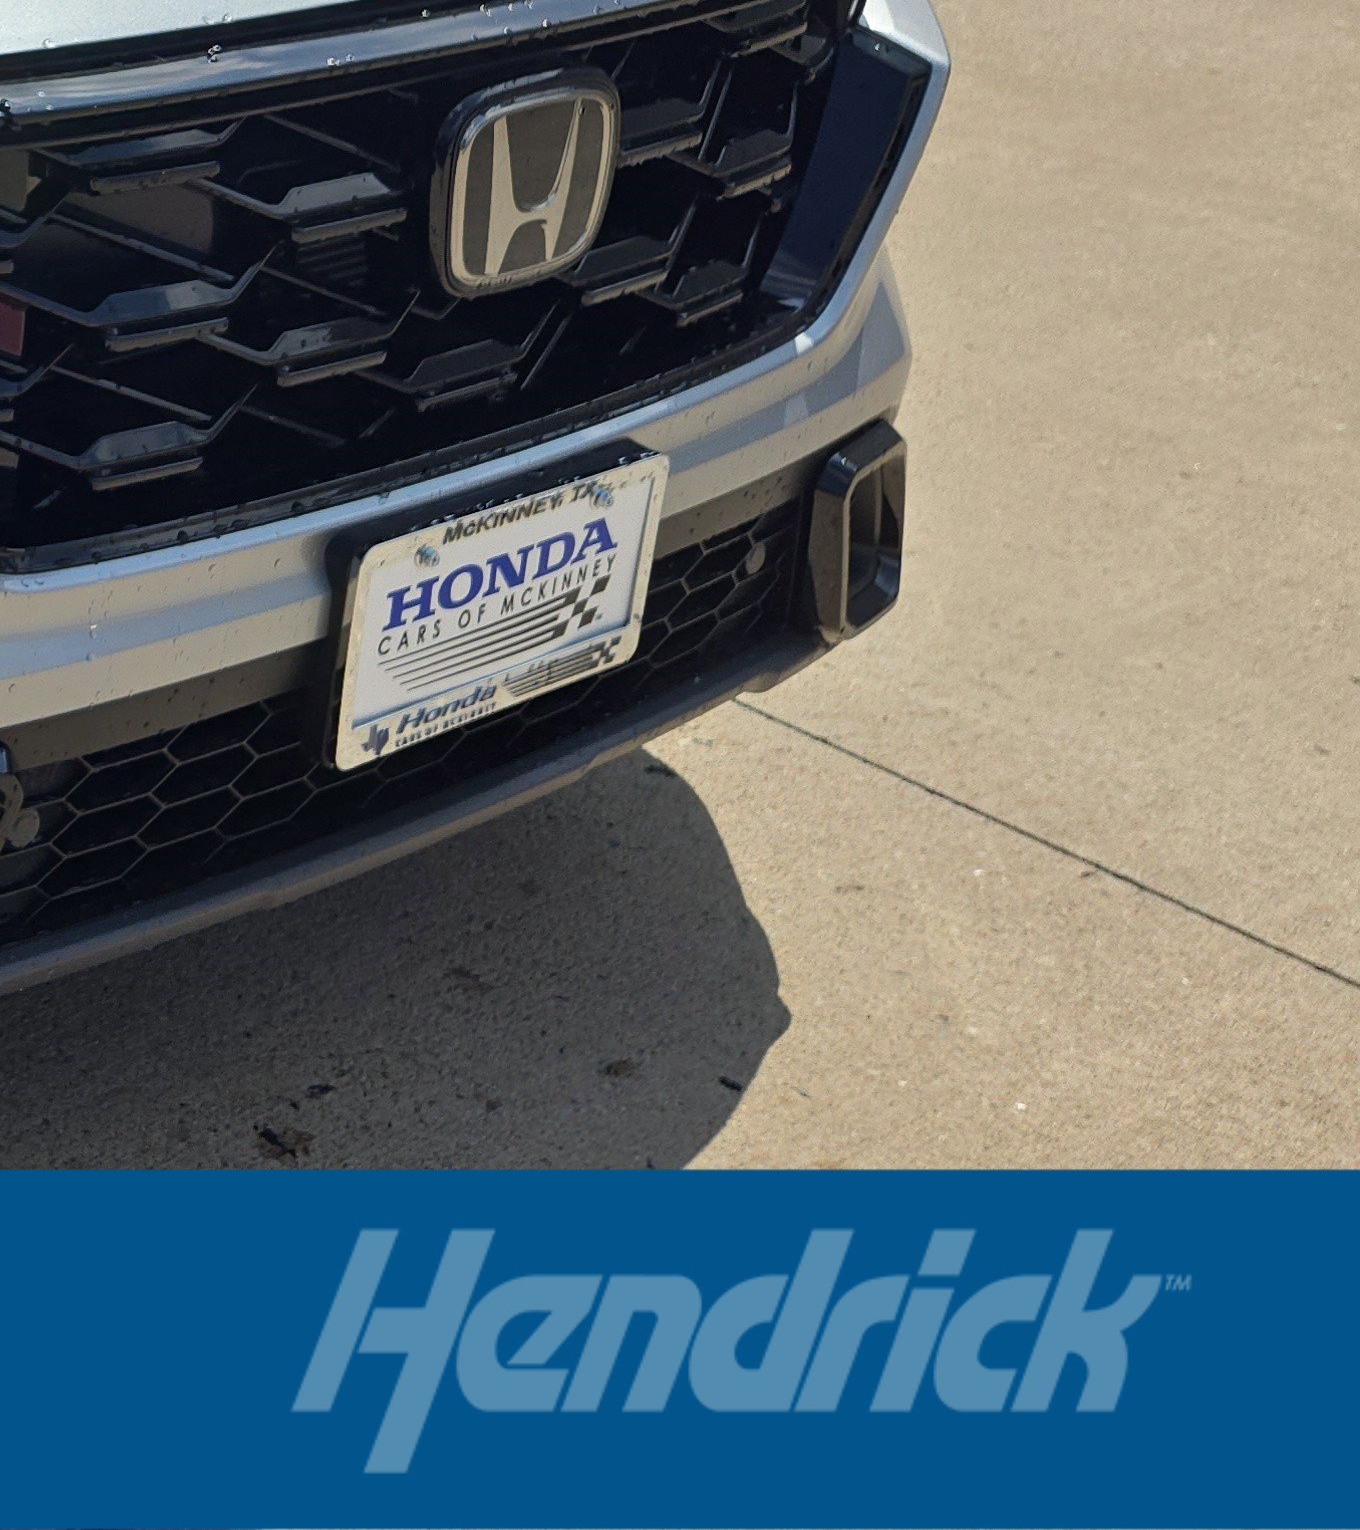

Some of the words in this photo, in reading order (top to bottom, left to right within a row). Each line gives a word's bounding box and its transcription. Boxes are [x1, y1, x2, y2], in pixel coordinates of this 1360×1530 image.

[377, 620, 442, 656] CARS
[458, 603, 486, 630] OF
[500, 553, 618, 616] MCKINNEY
[382, 516, 618, 631] HONDA
[396, 683, 497, 735] Honda
